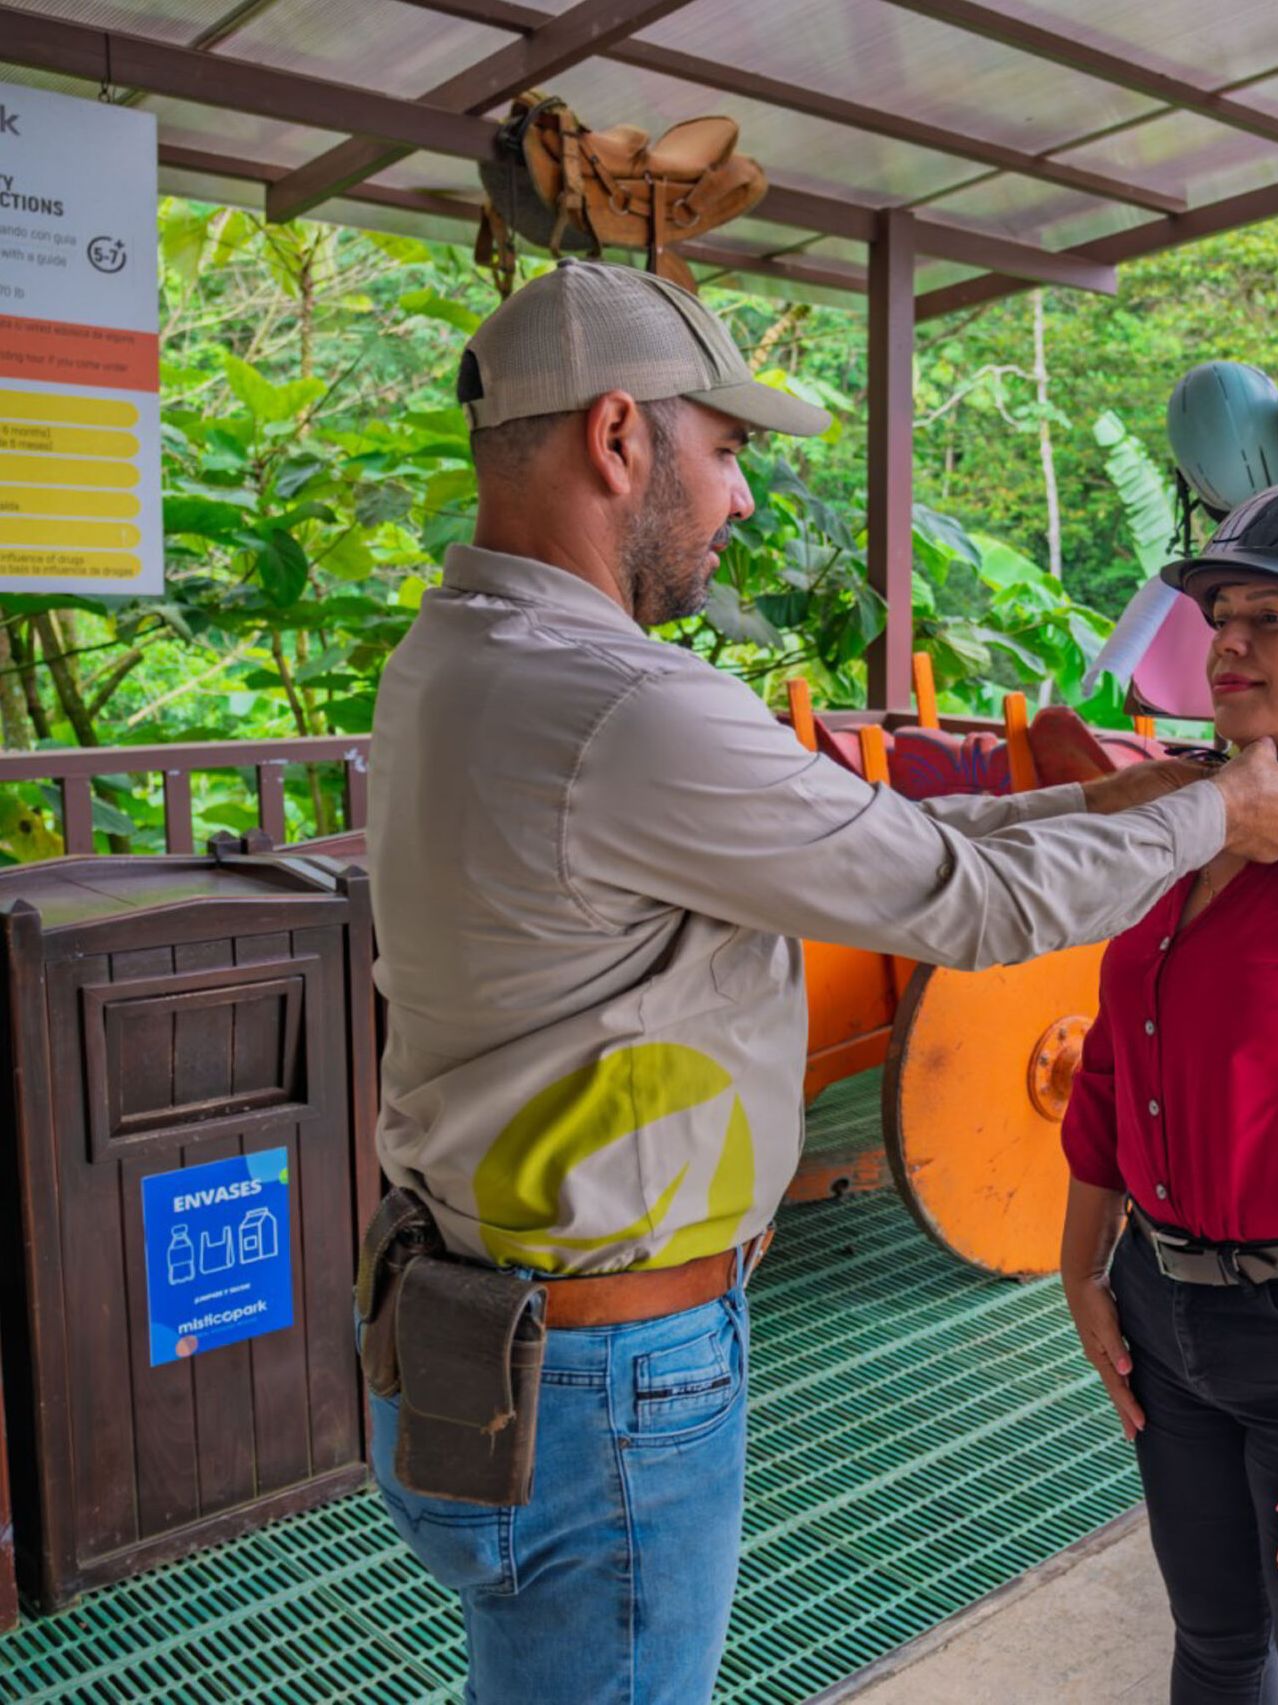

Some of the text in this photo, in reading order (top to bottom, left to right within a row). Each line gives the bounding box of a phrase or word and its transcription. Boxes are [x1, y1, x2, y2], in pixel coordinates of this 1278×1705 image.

[0, 104, 20, 136] k
[0, 191, 64, 217] CTIONS
[173, 1179, 262, 1213] ENVASES
